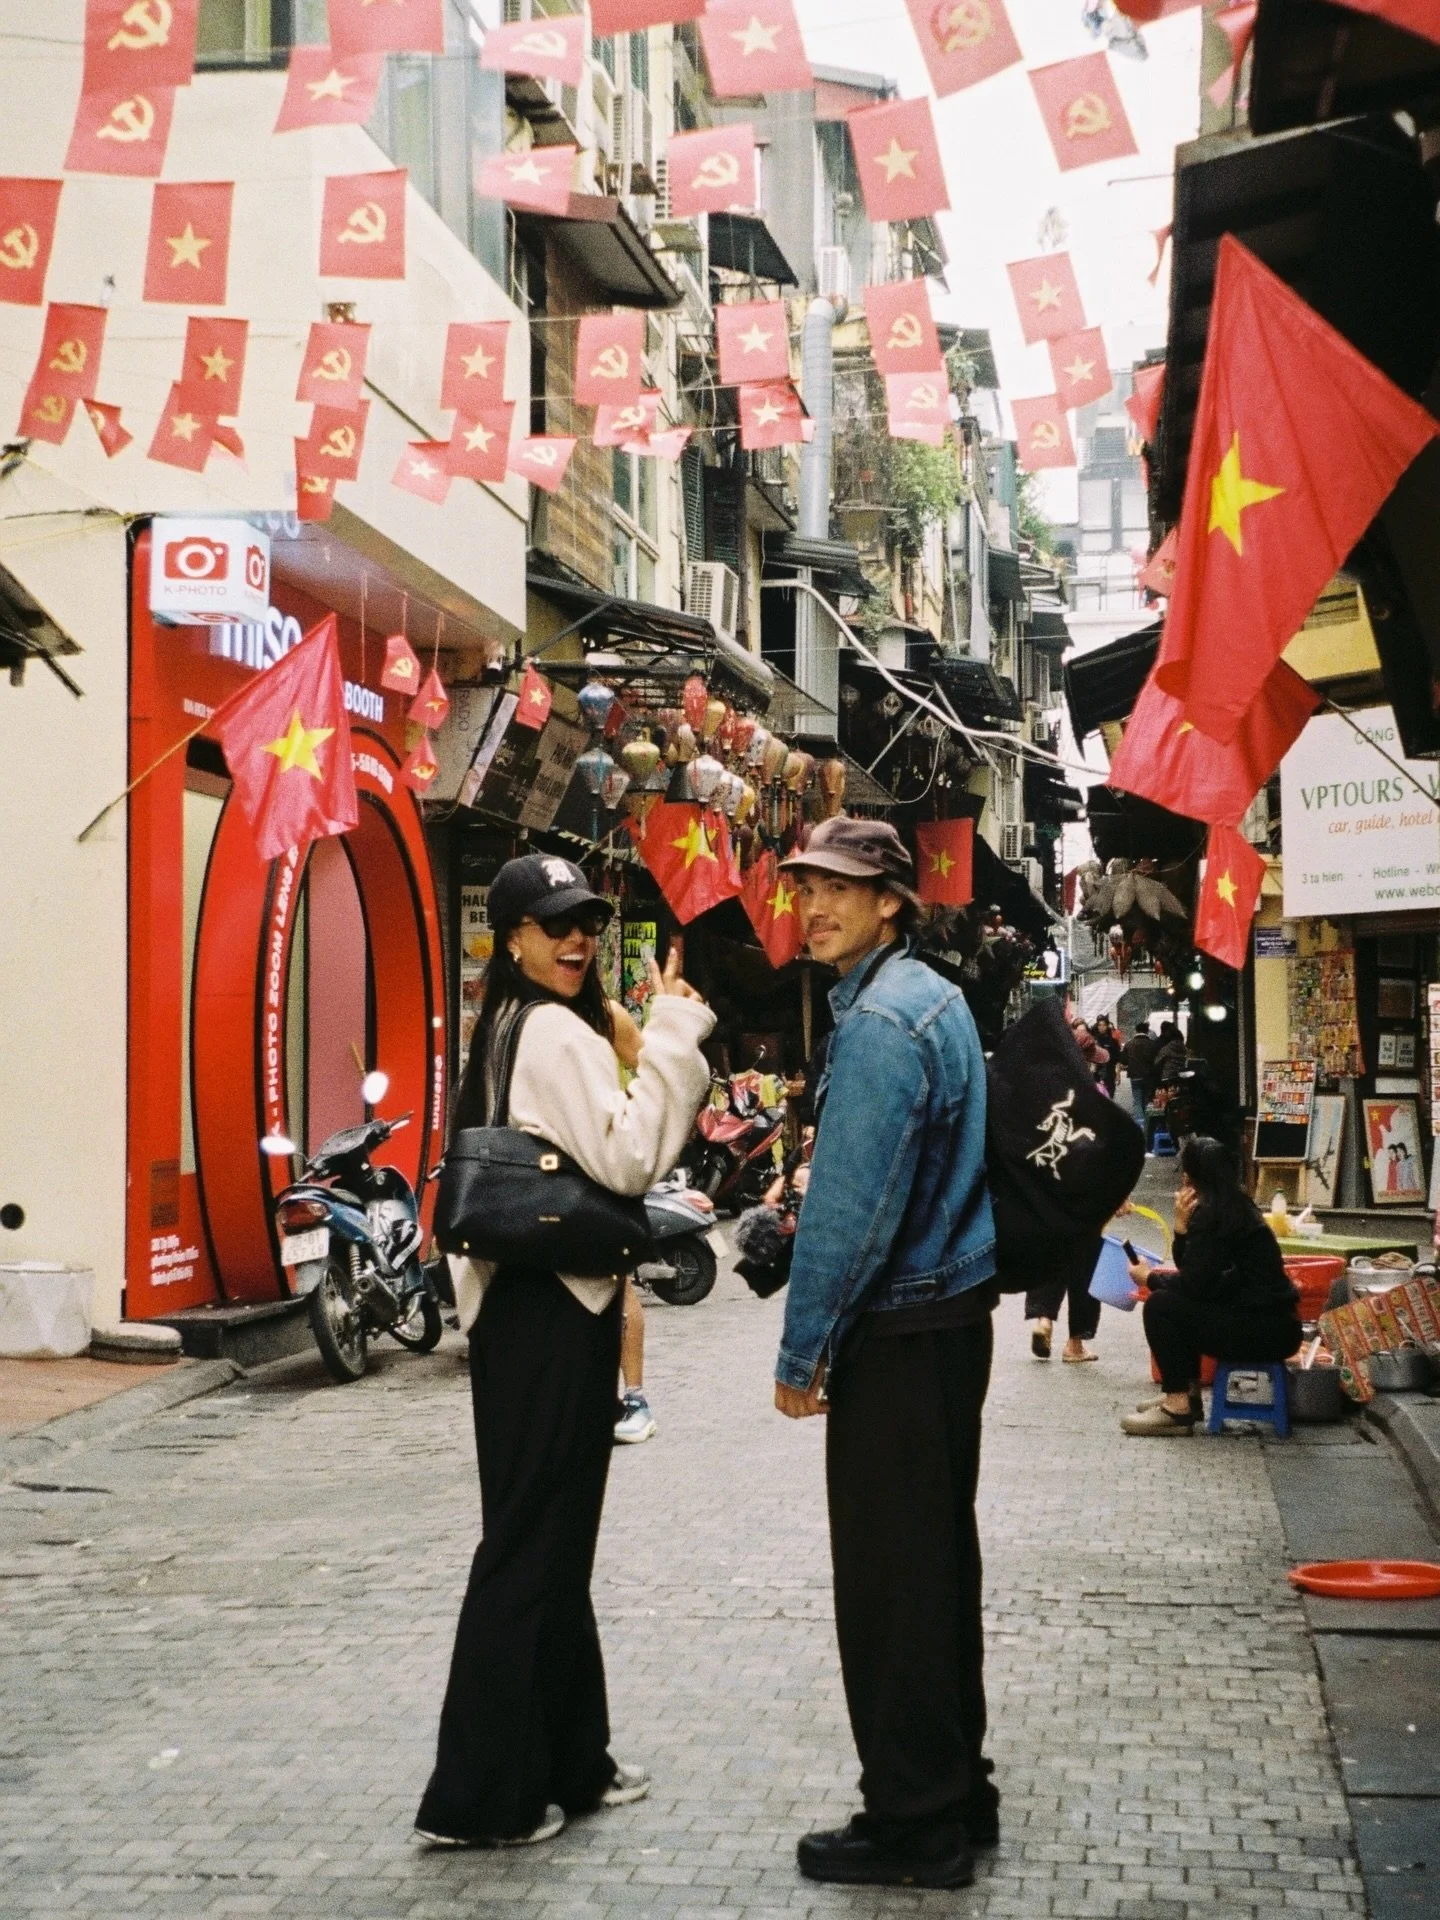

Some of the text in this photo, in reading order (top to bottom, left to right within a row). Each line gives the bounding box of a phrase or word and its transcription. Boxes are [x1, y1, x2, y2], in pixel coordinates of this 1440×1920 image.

[343, 680, 384, 723] BOOTH
[1354, 727, 1395, 745] CÔNG
[1301, 776, 1404, 811] VPTOURS
[1399, 808, 1433, 827] hotel
[1373, 867, 1410, 879] Hotline
[275, 865, 293, 929] LENS
[269, 929, 283, 1007] ZOOM
